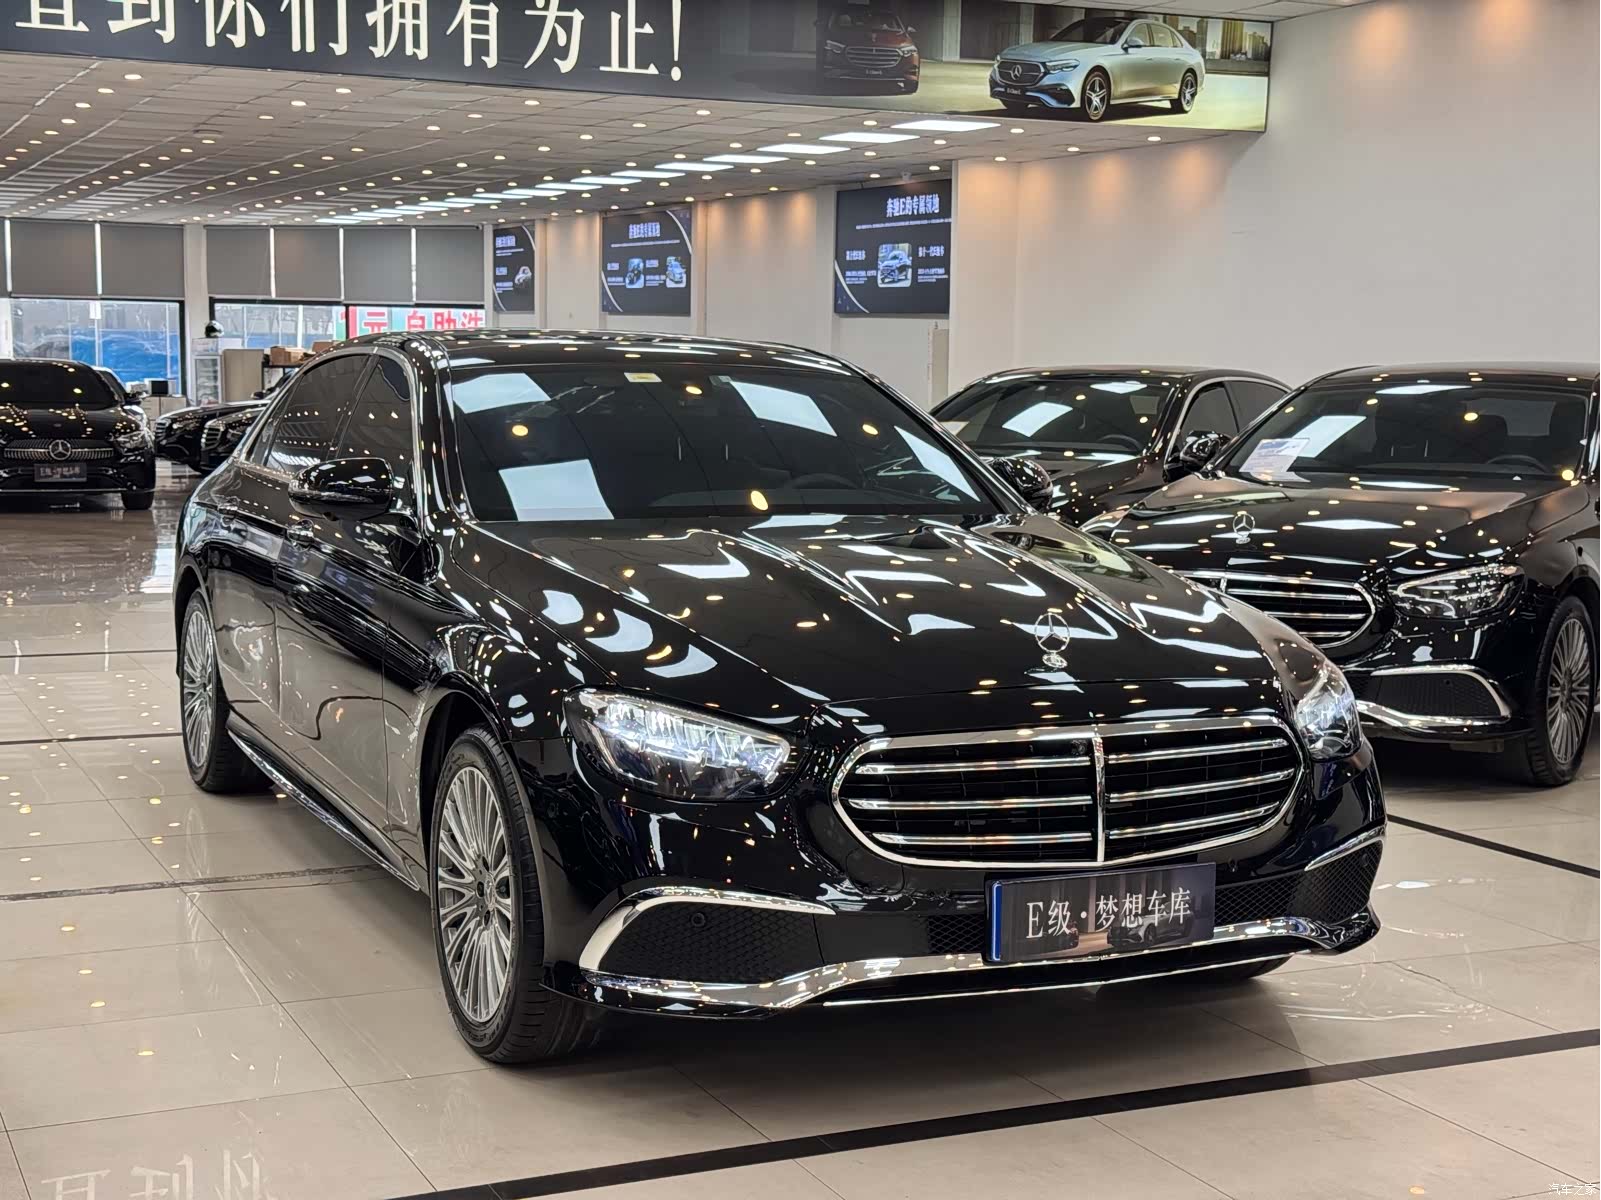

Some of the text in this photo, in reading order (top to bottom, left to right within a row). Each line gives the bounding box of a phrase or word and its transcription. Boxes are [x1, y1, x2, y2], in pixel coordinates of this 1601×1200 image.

[1026, 886, 1191, 939] E级·梦想车库
